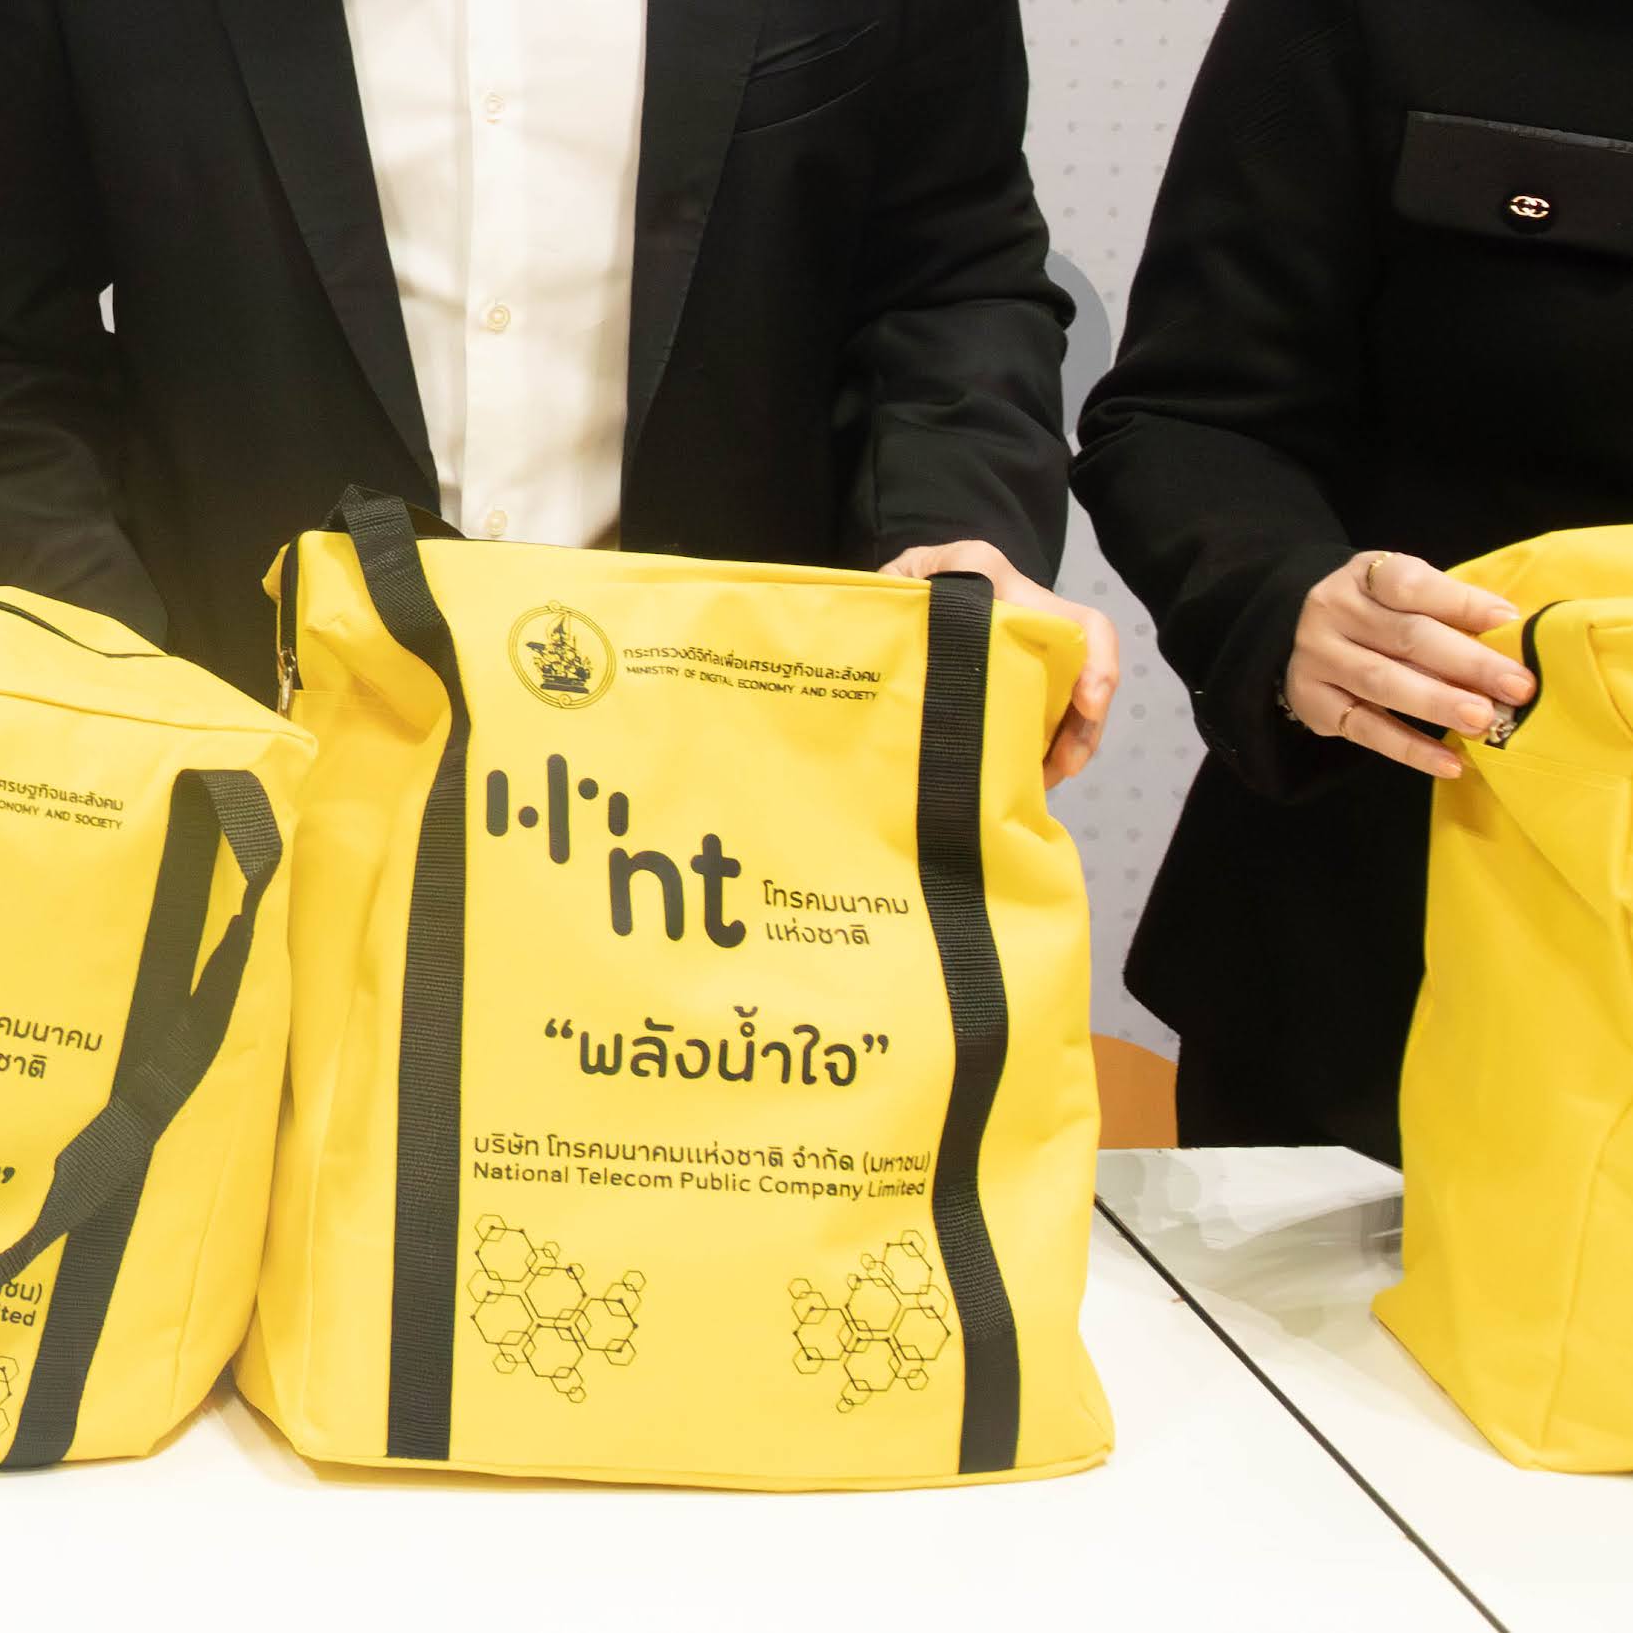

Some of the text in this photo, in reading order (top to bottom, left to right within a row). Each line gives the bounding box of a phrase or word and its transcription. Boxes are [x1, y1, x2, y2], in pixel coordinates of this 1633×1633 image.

[626, 664, 878, 701] MINISTRY OF DIGITAL ECONOMY AND SOCIETY
[45, 808, 71, 822] AND
[74, 812, 123, 830] SOCIETY
[608, 833, 747, 949] nt
[763, 879, 910, 915] โทรคมนาคม
[766, 918, 870, 945] แห่งชาติ
[474, 1132, 931, 1176] บริษัท โทรคมนาคมแห่งชาติ จำกัด (มหาชน)
[473, 1162, 925, 1201] National Telecom Public Company Limited
